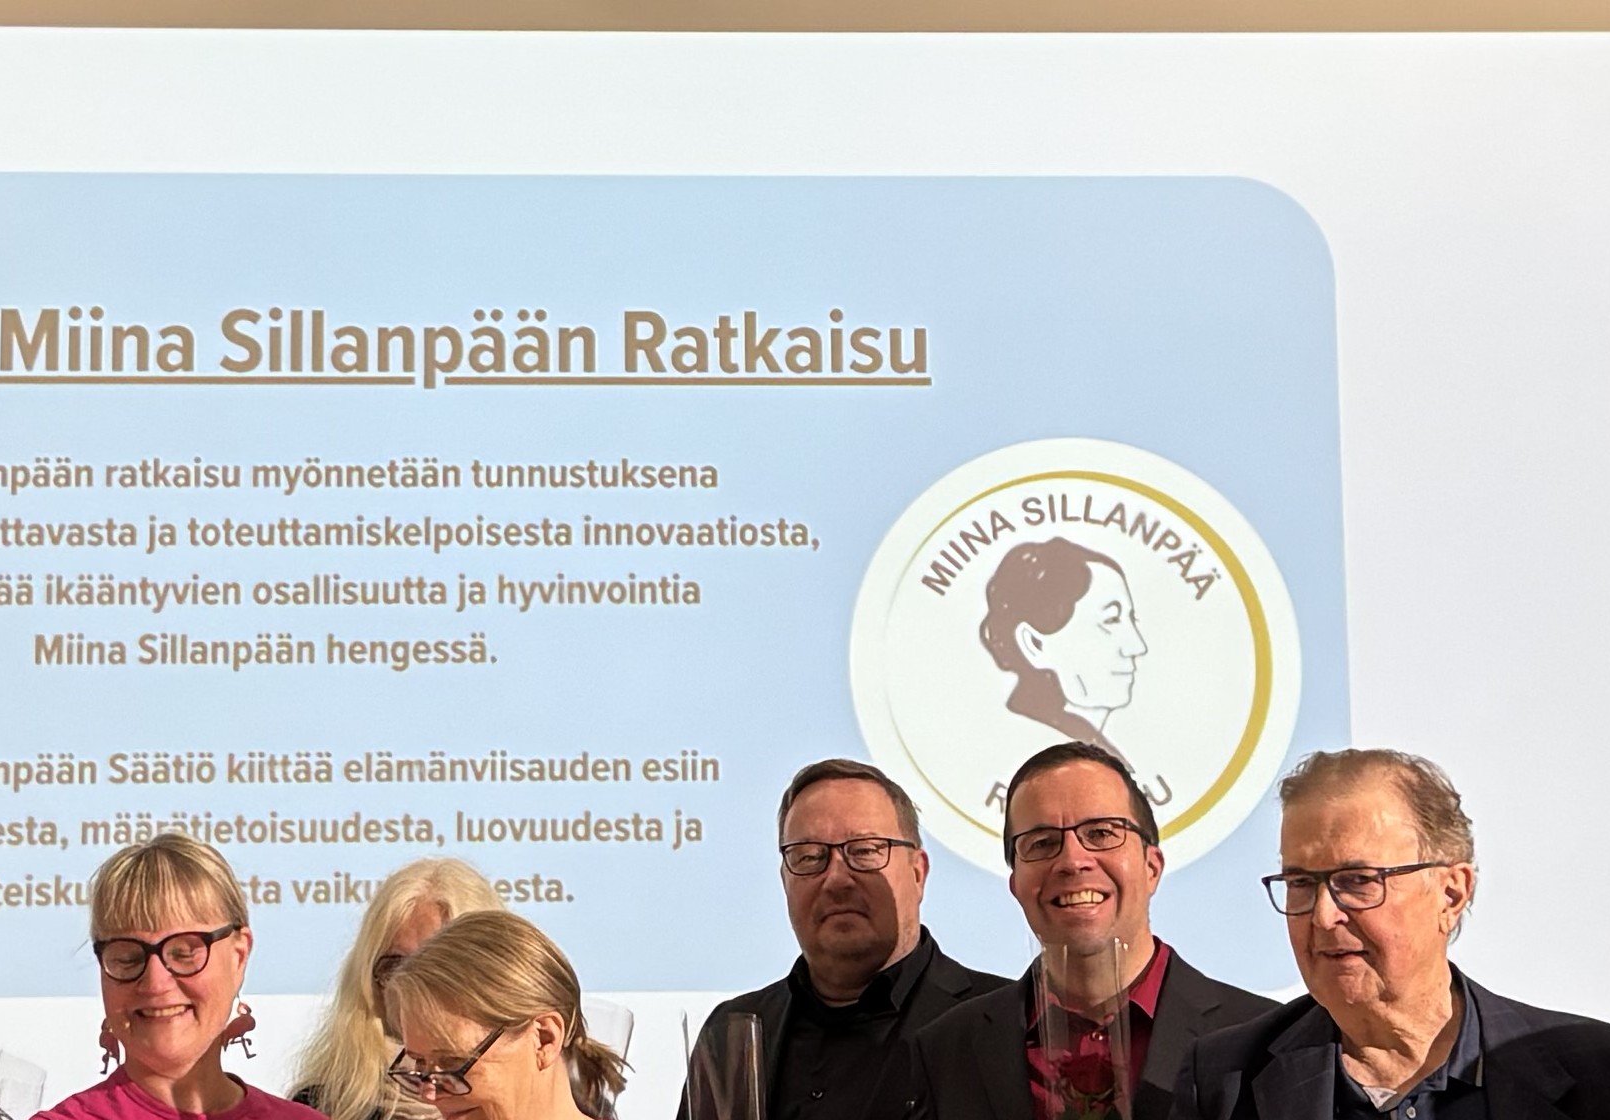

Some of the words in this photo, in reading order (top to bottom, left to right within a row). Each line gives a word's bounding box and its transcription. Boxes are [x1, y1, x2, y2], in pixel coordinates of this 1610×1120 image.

[219, 306, 597, 389] Sillanpään
[623, 307, 930, 375] Ratkaisu
[105, 458, 241, 488] ratkaisu
[252, 458, 462, 496] myönnetään
[472, 458, 719, 489] tunnustuksena
[146, 515, 177, 554] ja
[188, 515, 573, 553] toteuttamiskelpoisesta
[583, 515, 820, 551] innovaatiosta,
[921, 510, 1015, 597] MIINA
[1021, 492, 1223, 601] SILLANPÄÄ
[45, 573, 242, 613] ikääntyvien
[252, 574, 447, 606] osallisuutta
[457, 573, 486, 612] ja
[497, 573, 701, 613] hyvinvointia
[33, 632, 127, 666] Miina
[137, 632, 315, 672] Sillanpään
[325, 631, 497, 672] hengessä.
[108, 751, 215, 785] Säätiö
[226, 750, 333, 784] kiittää
[342, 750, 631, 783] elämänviisauden
[641, 751, 720, 782] esiin
[455, 810, 664, 843] luovuudesta
[673, 810, 703, 850] ja
